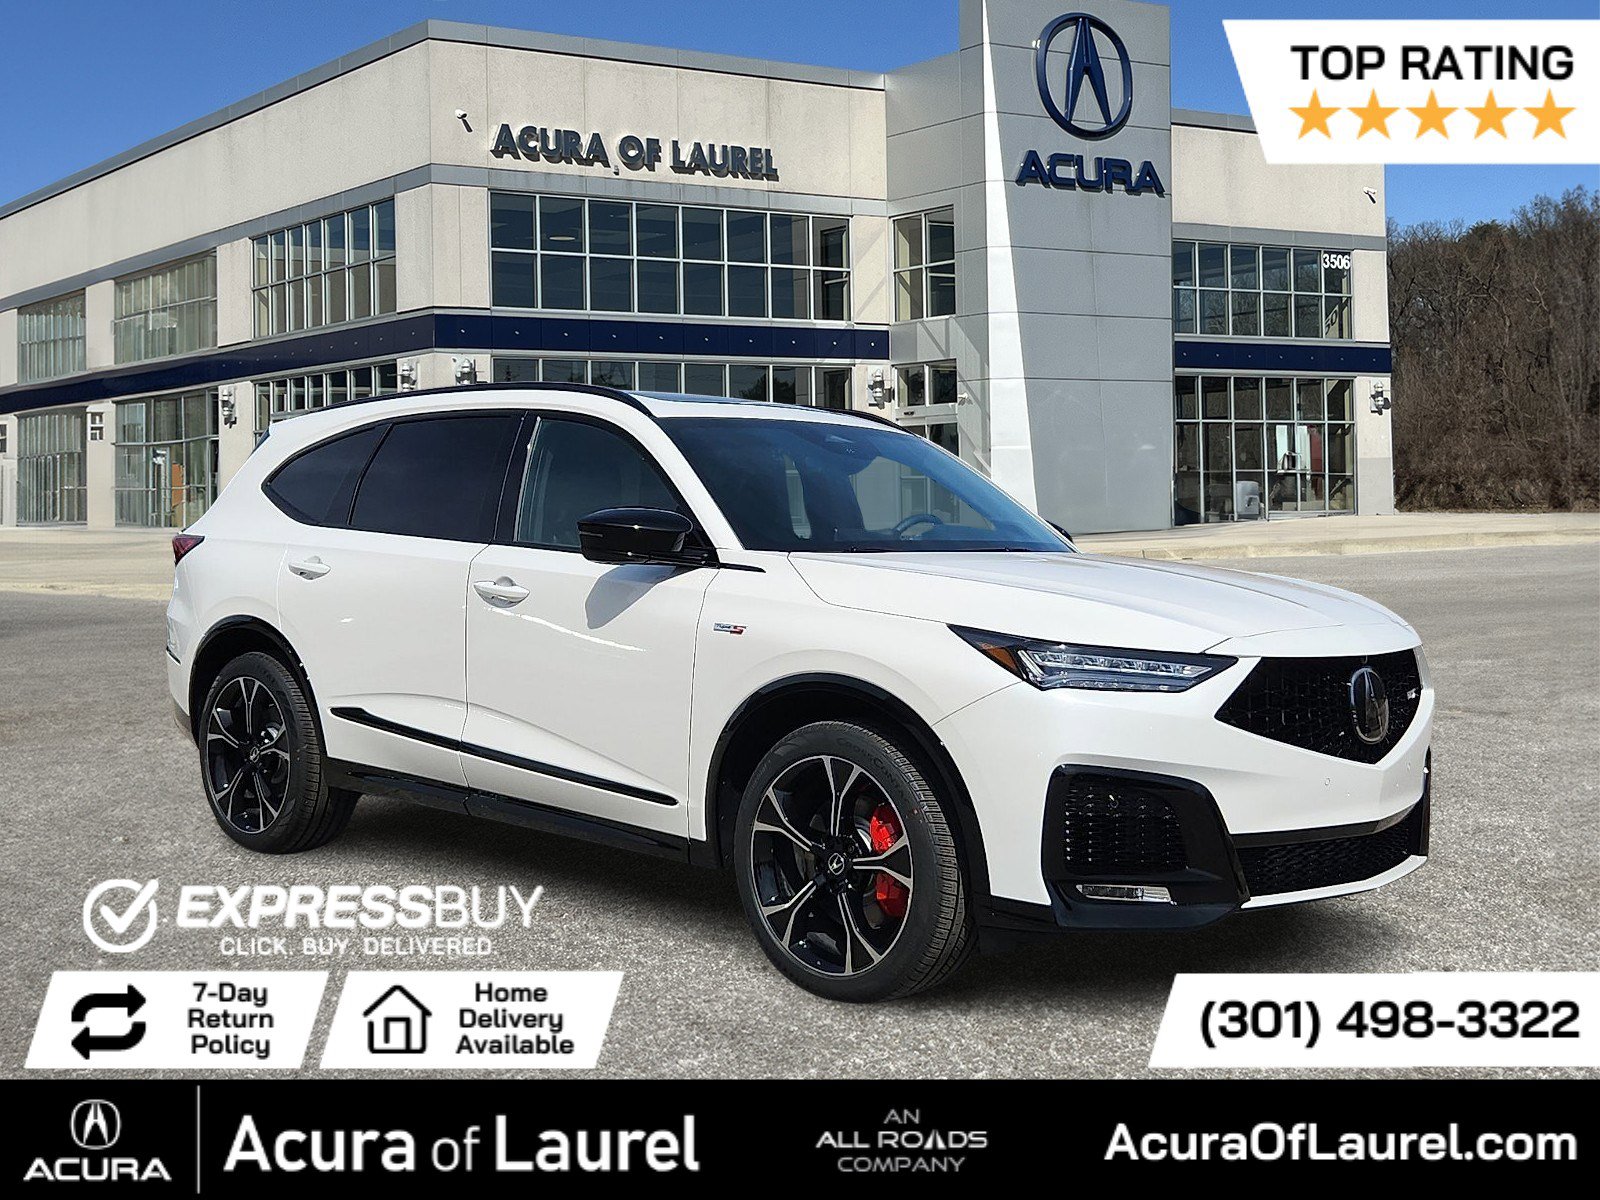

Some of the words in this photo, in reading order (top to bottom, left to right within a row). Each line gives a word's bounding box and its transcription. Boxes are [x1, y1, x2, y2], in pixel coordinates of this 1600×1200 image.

[493, 123, 610, 166] ACURA
[617, 135, 662, 172] OF
[671, 140, 779, 181] LAUREL
[1016, 150, 1165, 197] ACURA
[1322, 253, 1351, 270] 3506
